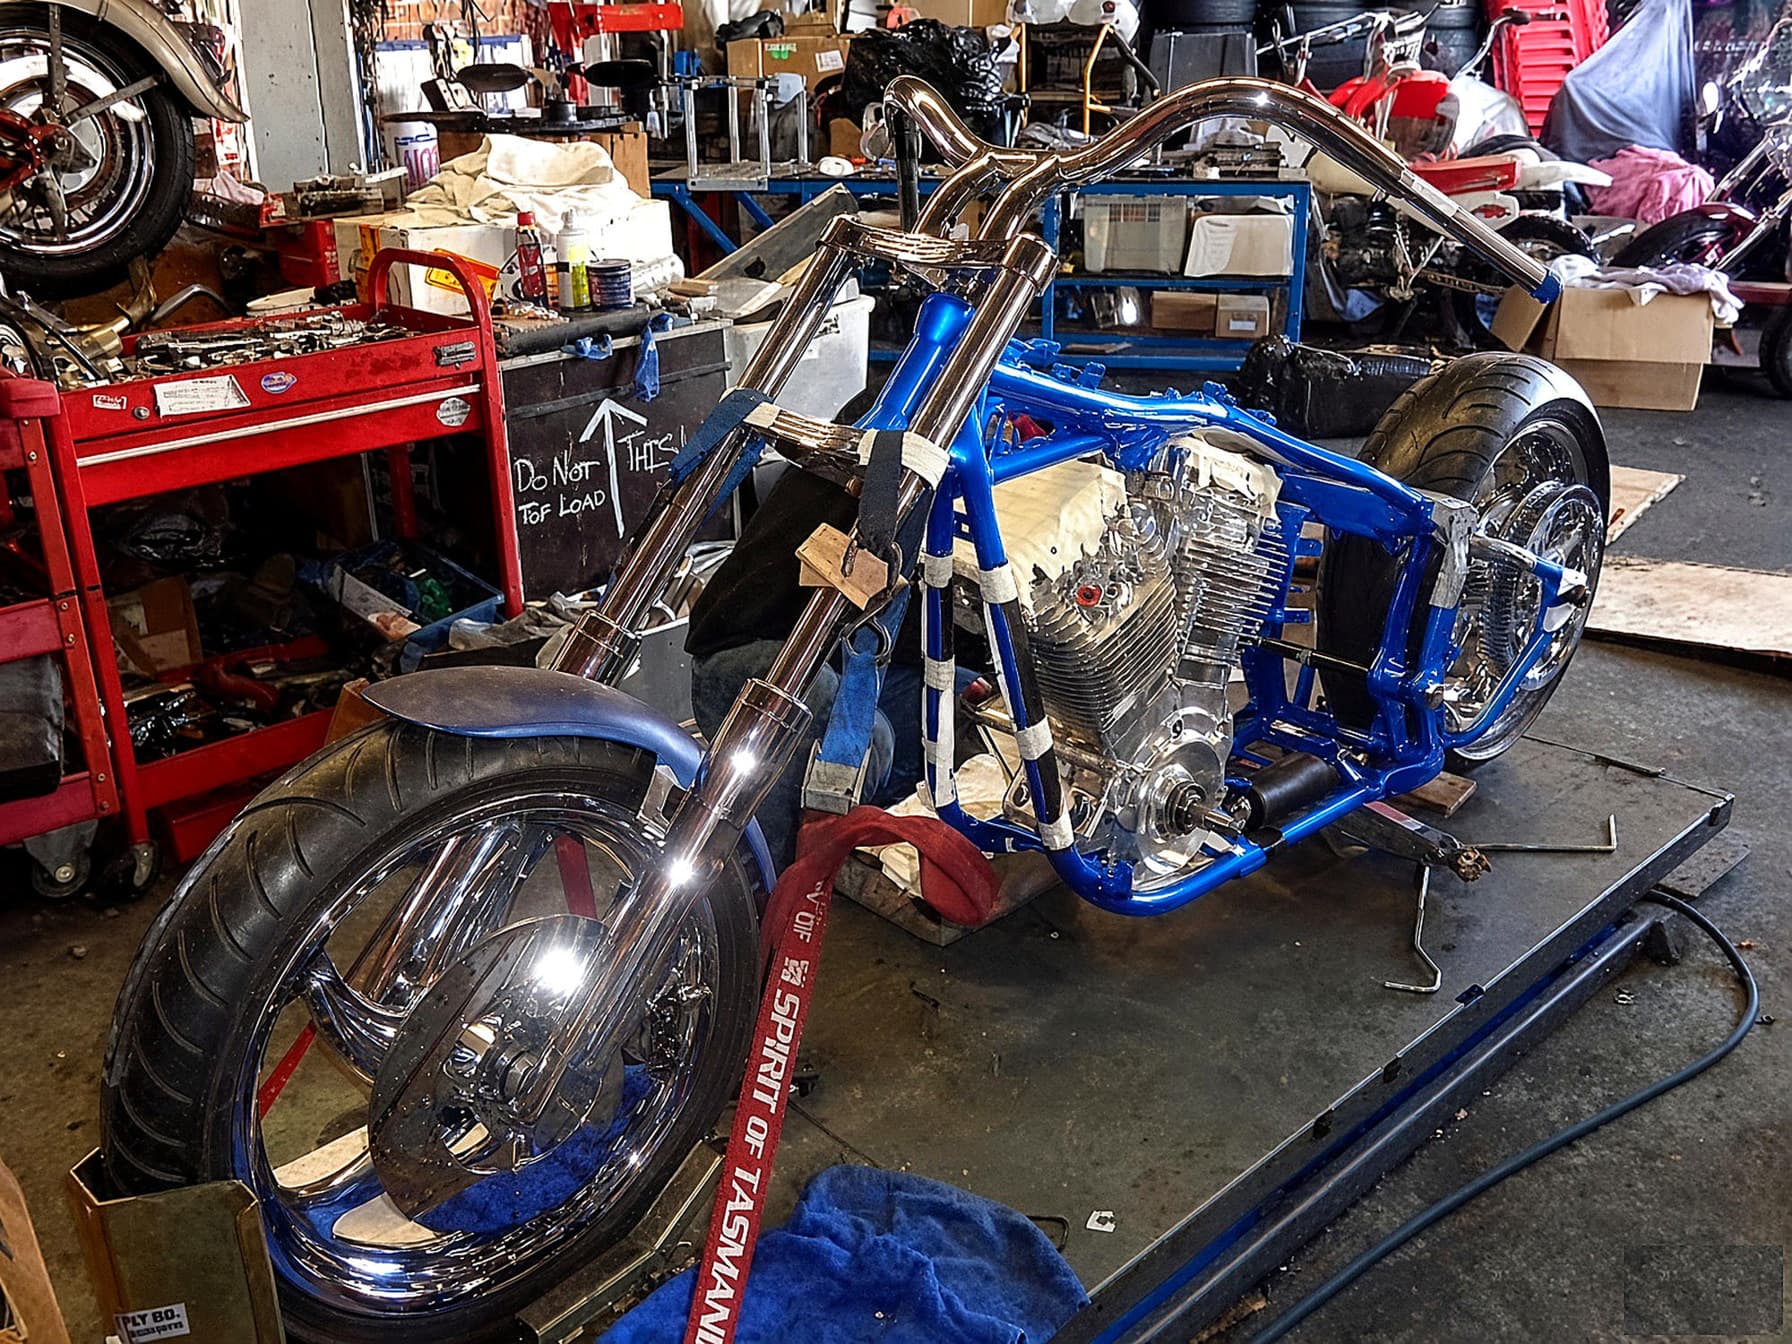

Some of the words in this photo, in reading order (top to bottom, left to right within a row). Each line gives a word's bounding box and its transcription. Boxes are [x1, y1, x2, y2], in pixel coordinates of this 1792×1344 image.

[558, 489, 606, 517] LOAD
[753, 988, 800, 1115] SPIRIT
[744, 1115, 768, 1160] OF
